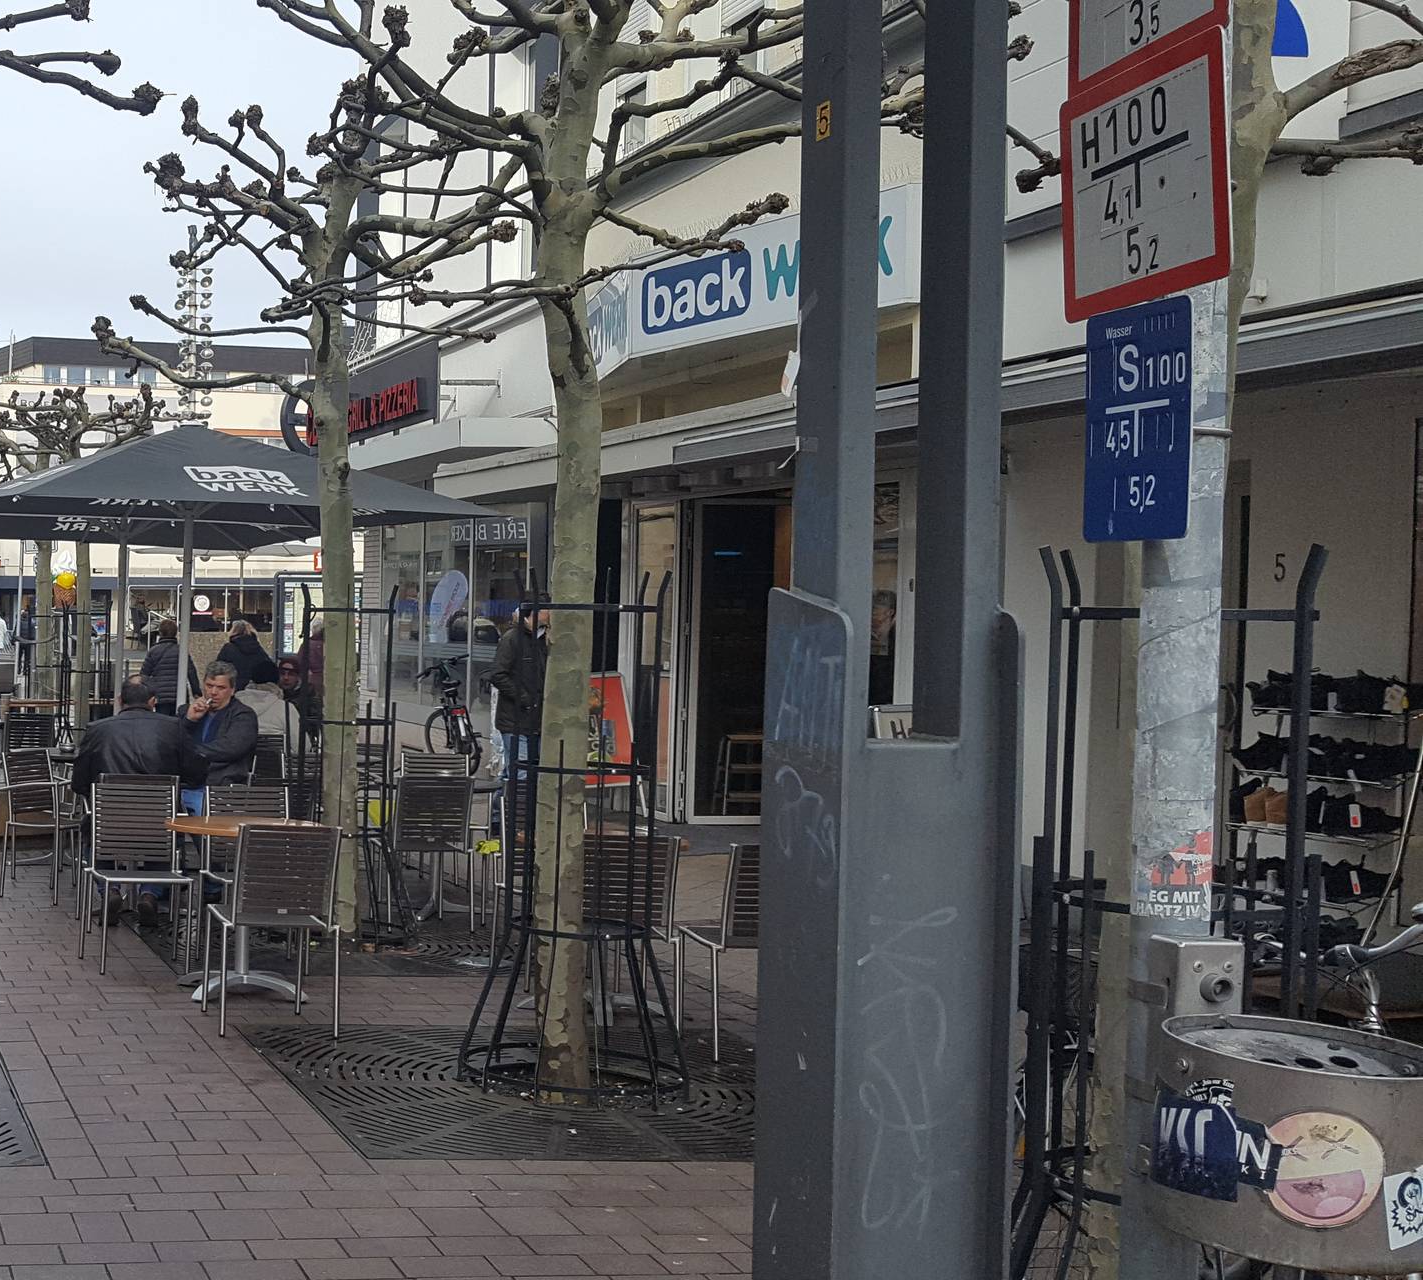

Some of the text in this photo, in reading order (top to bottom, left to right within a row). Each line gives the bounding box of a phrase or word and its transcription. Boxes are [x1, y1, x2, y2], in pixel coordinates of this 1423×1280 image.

[1129, 0, 1160, 46] 3,5
[819, 104, 829, 135] 5
[1080, 86, 1167, 169] H100
[1103, 179, 1134, 226] 4,1
[1127, 227, 1159, 275] 5,2
[646, 215, 894, 329] back WK
[1105, 325, 1133, 341] Wasser
[1118, 343, 1186, 392] S100
[370, 393, 378, 426] &
[378, 379, 418, 425] PIZZERIA
[1105, 419, 1131, 459] 4,5
[189, 467, 289, 486] back
[197, 481, 309, 498] WERK
[1129, 474, 1156, 514] 5,2
[1274, 553, 1286, 582] 5
[1148, 889, 1201, 904] EG MIT
[1185, 904, 1201, 917] IV
